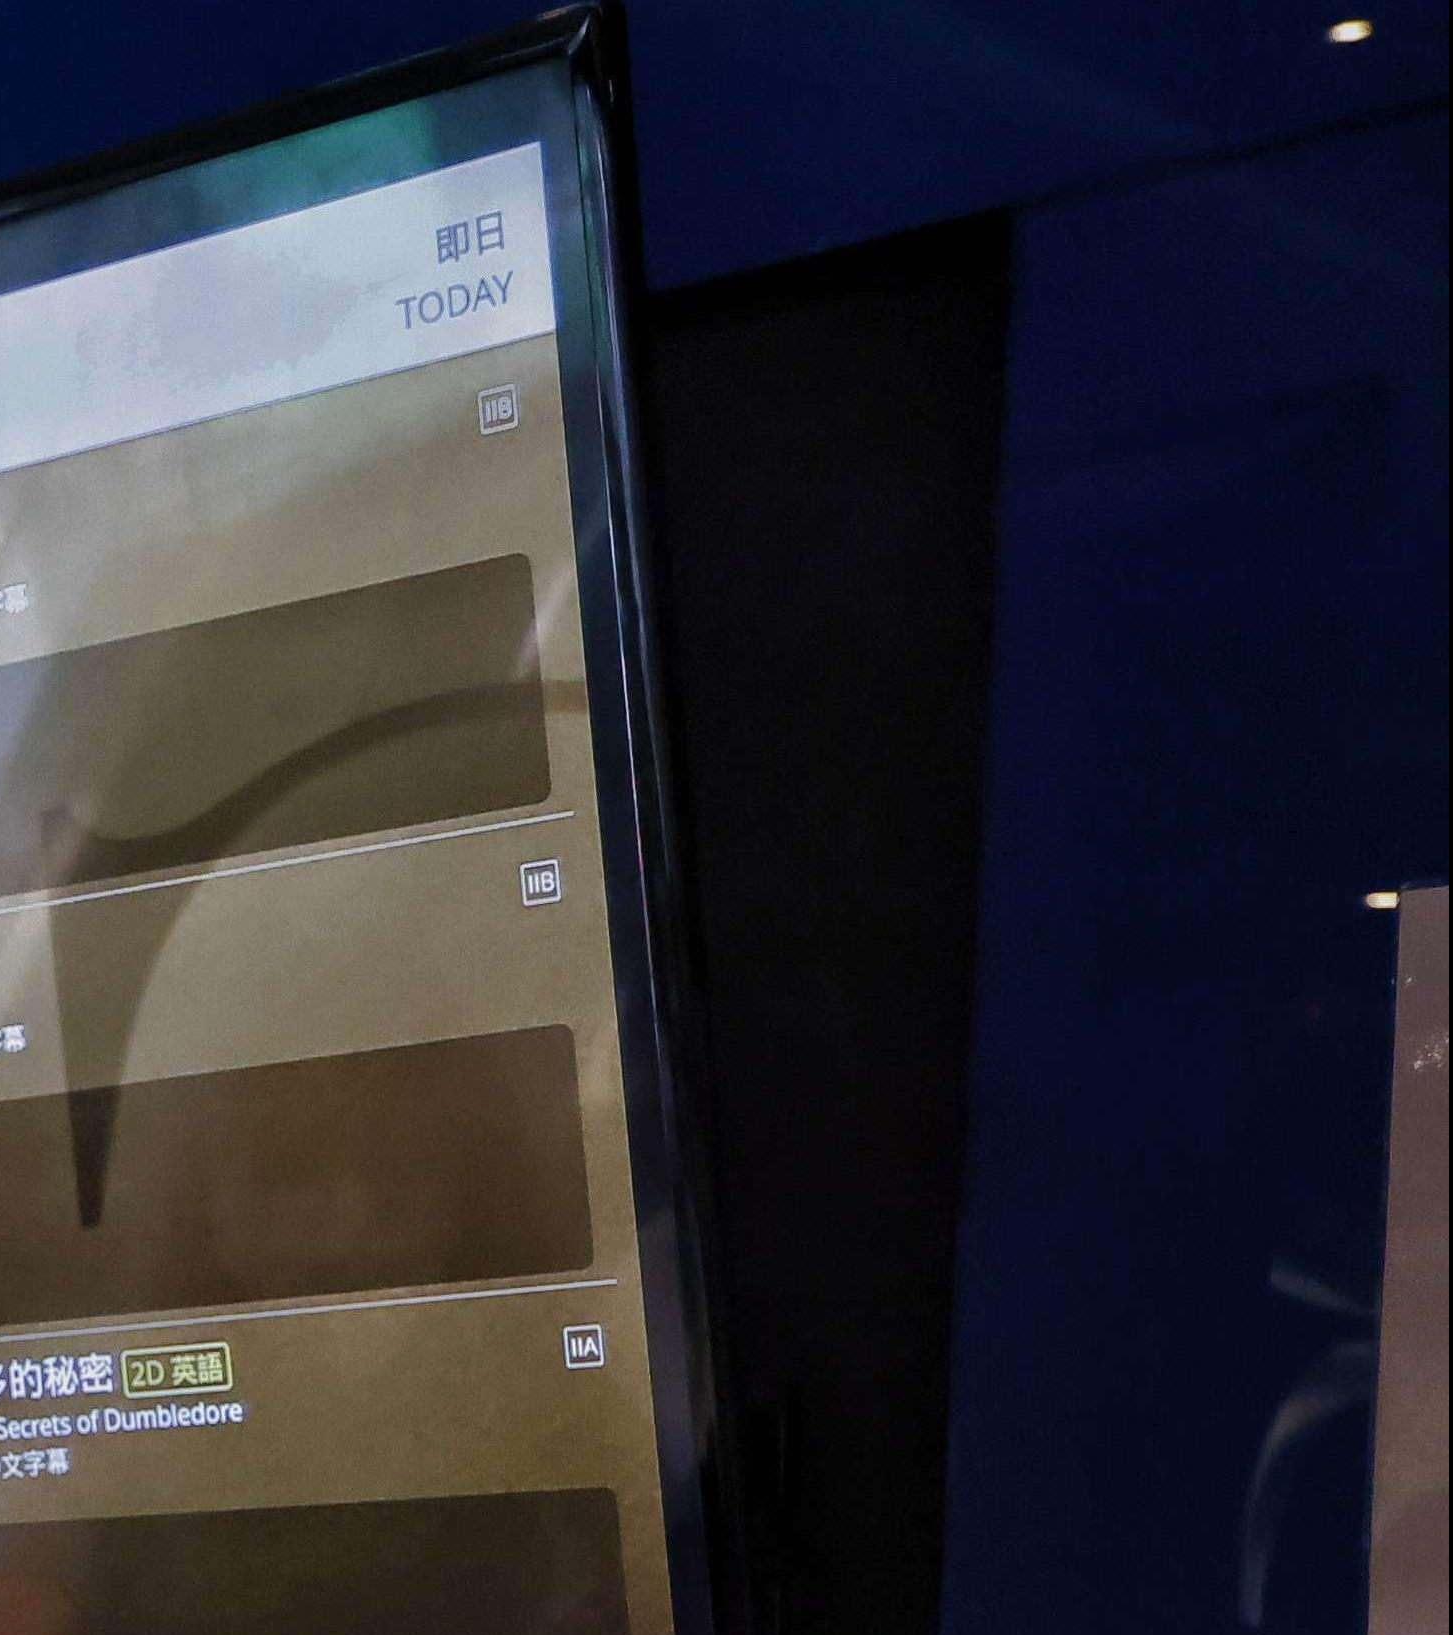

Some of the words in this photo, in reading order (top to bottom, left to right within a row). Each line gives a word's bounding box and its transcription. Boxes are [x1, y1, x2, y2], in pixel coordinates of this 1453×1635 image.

[435, 210, 506, 264] 即日
[395, 270, 514, 330] TODAY
[526, 871, 556, 898] IIB
[570, 1333, 597, 1359] IIA
[130, 1360, 166, 1389] 2D
[170, 1352, 224, 1387] 英語
[76, 1408, 100, 1435] of
[103, 1401, 245, 1434] Dumbledore
